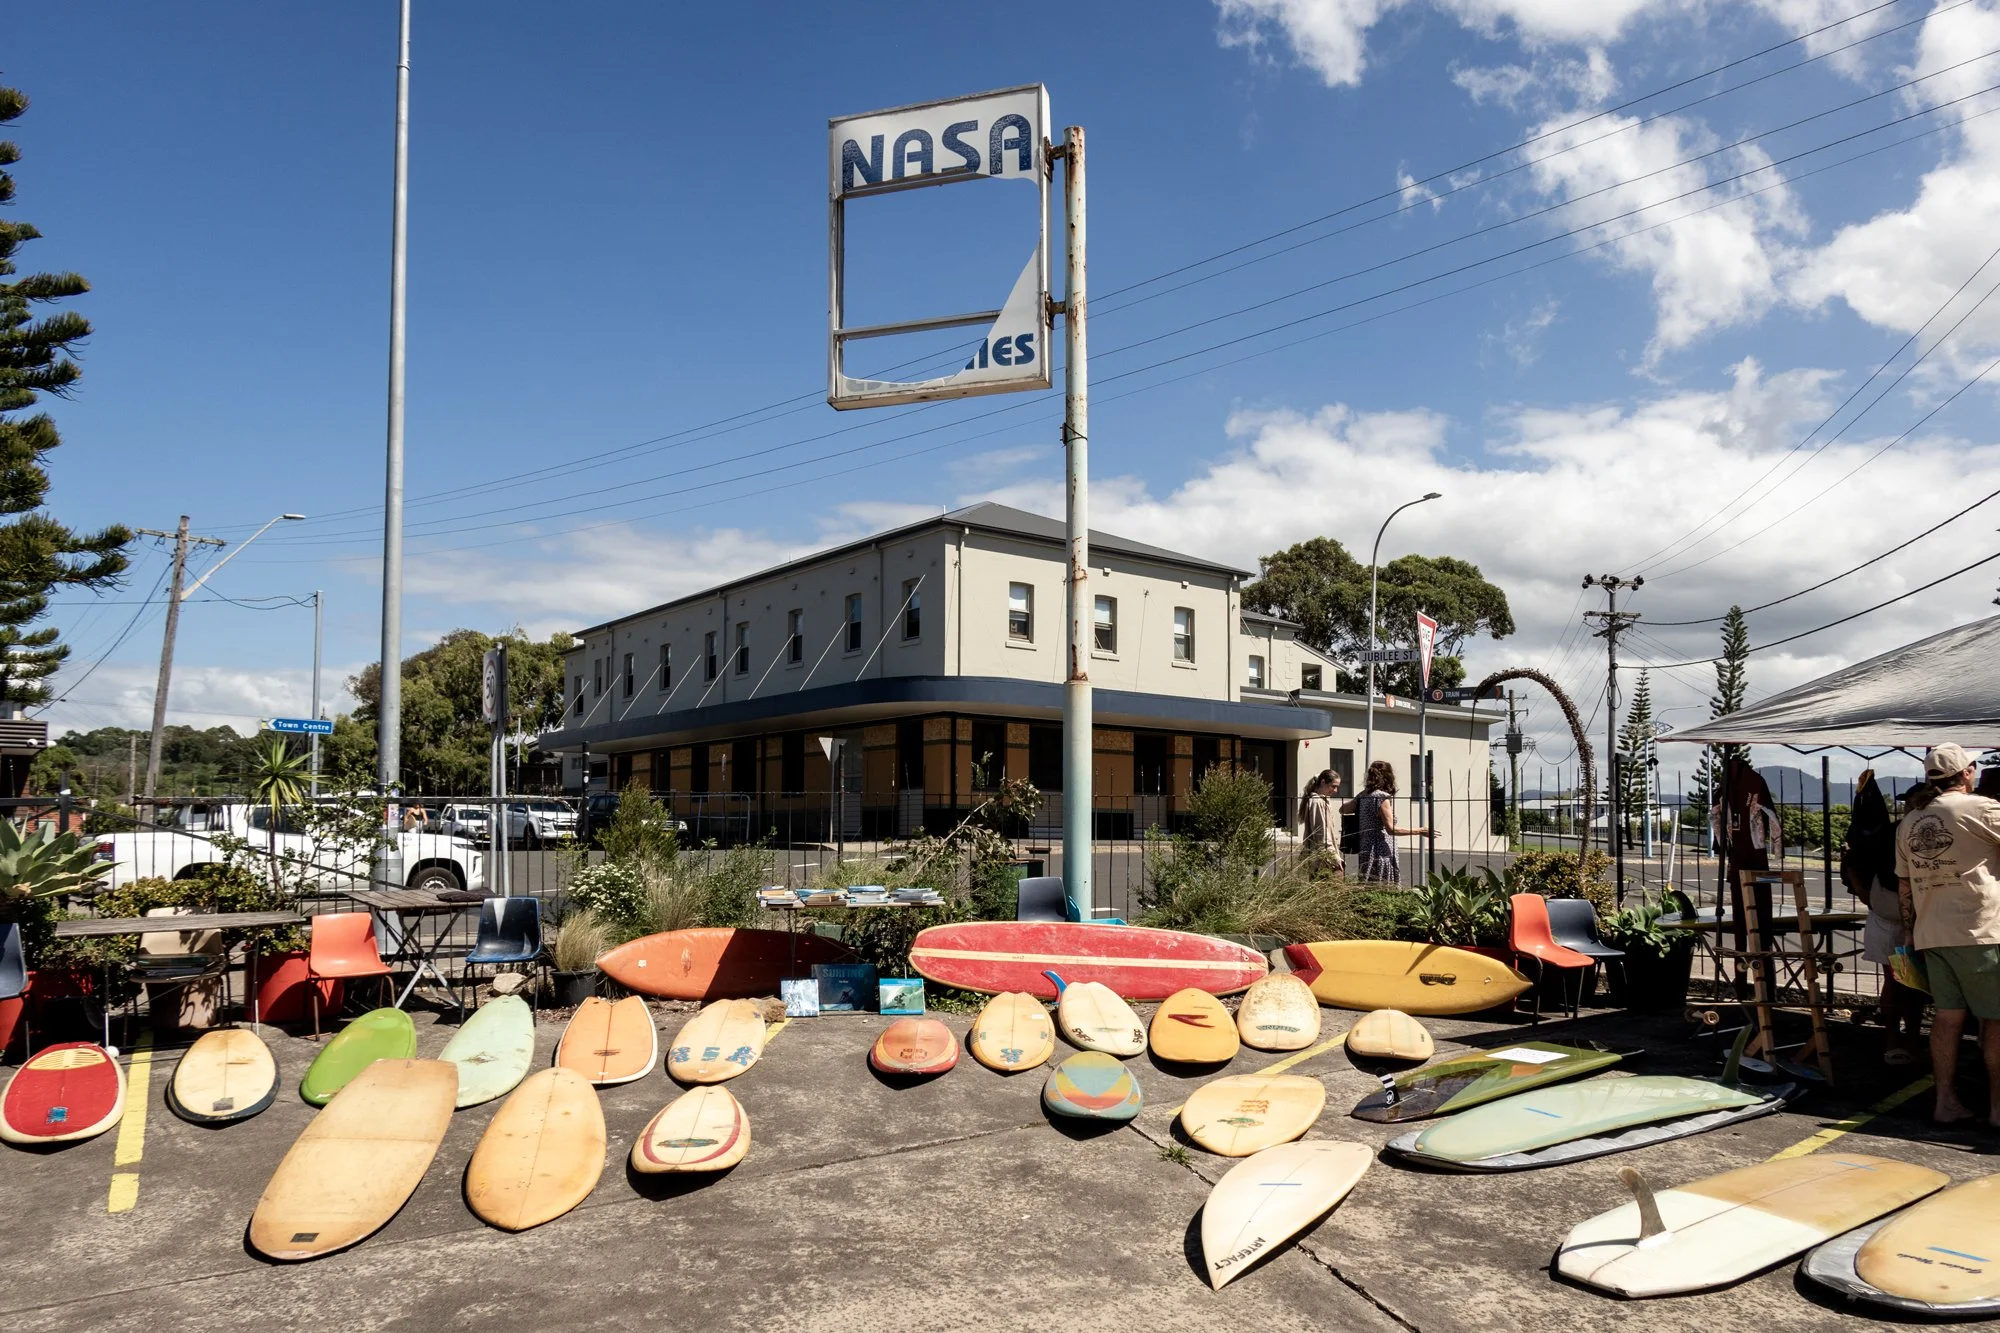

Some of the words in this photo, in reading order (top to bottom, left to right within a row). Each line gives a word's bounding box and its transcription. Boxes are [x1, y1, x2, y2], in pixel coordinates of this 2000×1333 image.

[842, 113, 1032, 193] NASA
[965, 333, 1035, 370] IES
[1362, 651, 1399, 662] JUBILEE
[1403, 650, 1414, 660] ST
[486, 674, 495, 700] 50
[277, 721, 299, 729] Town
[302, 722, 330, 731] Centre
[823, 968, 865, 978] SURFING
[1214, 1236, 1266, 1271] ARTEFACT
